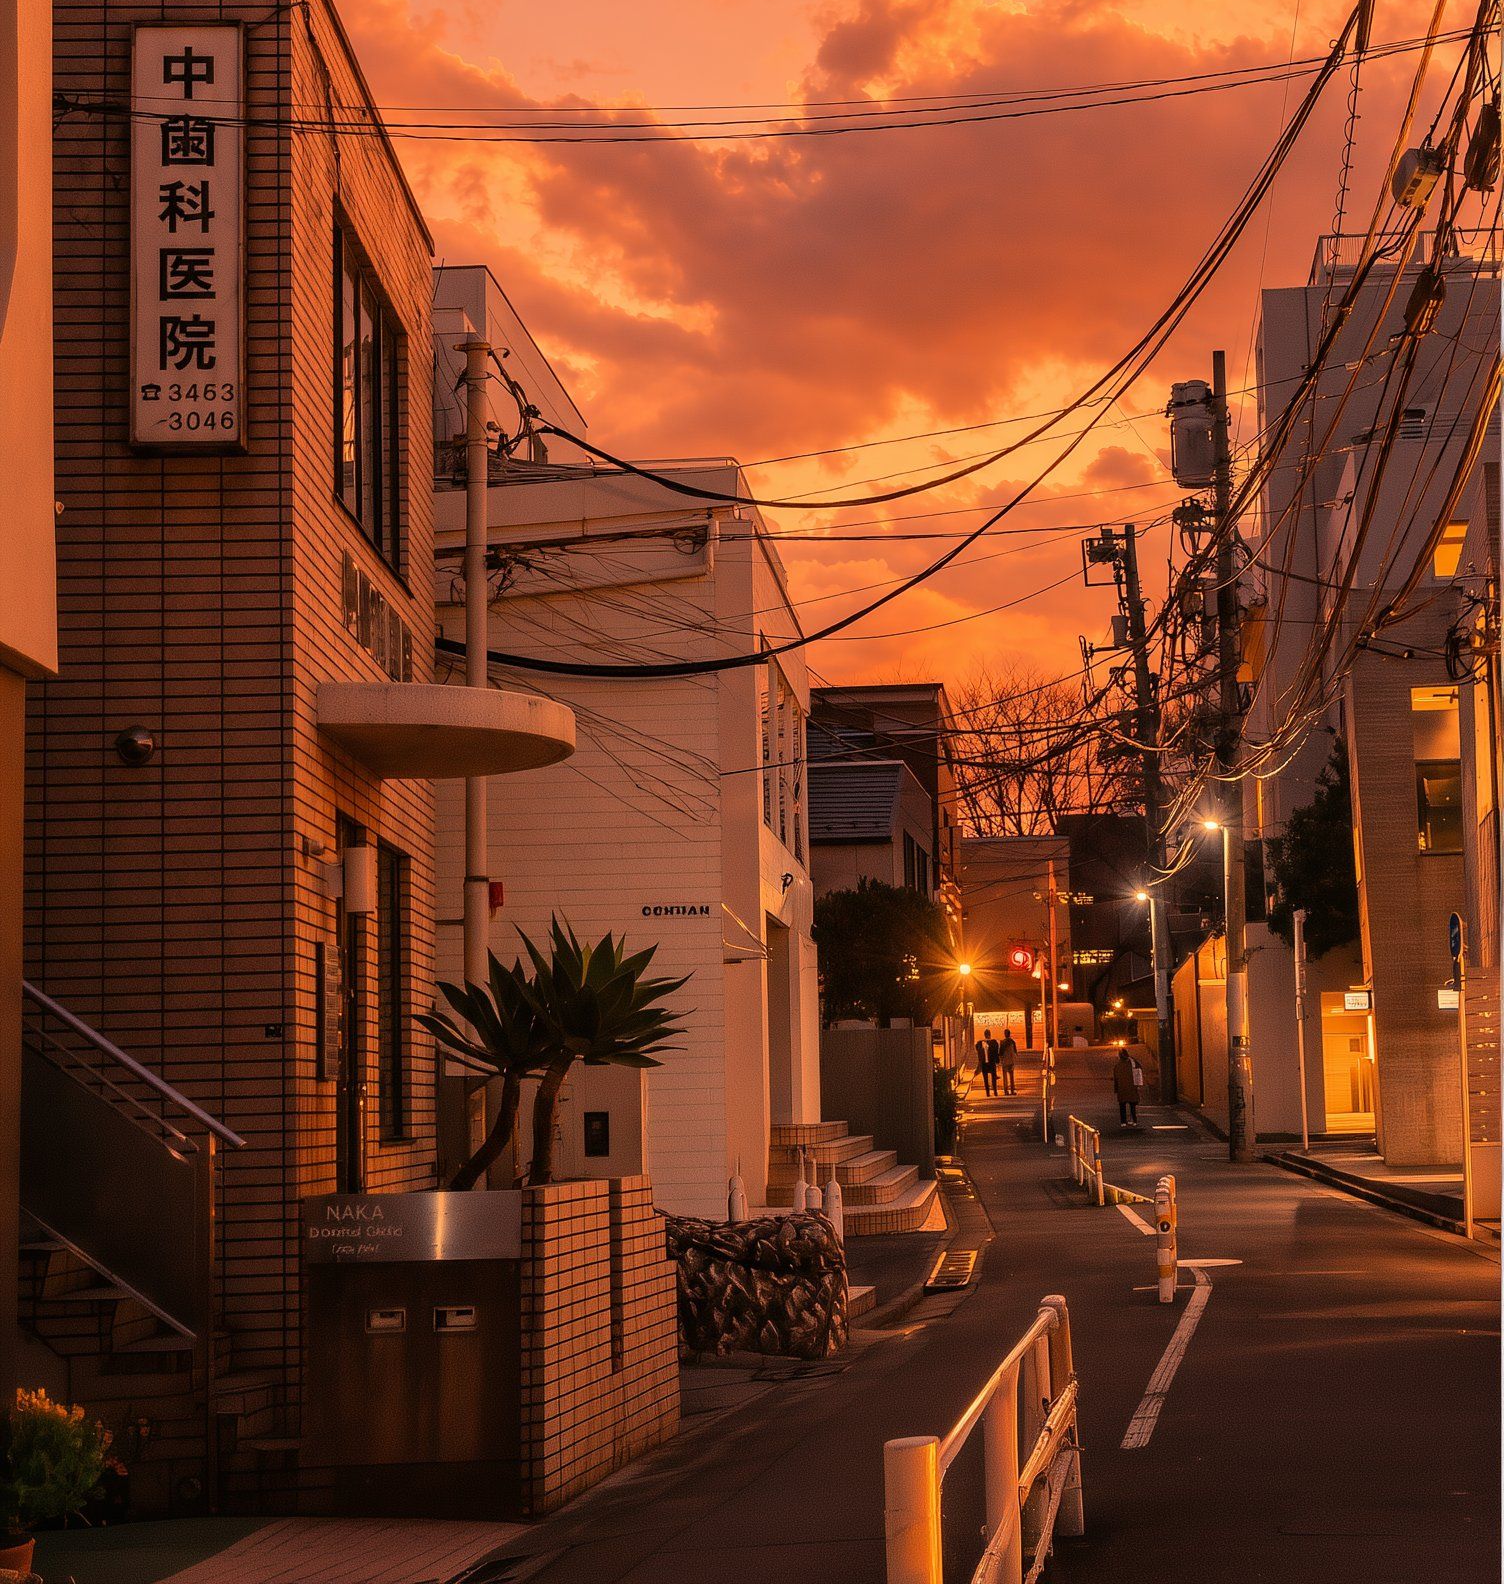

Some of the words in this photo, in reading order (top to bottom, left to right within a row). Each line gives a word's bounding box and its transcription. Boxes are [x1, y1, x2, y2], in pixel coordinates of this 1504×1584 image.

[159, 46, 217, 372] 中歯科医院
[168, 382, 235, 402] 3463
[326, 1204, 385, 1220] NAKA
